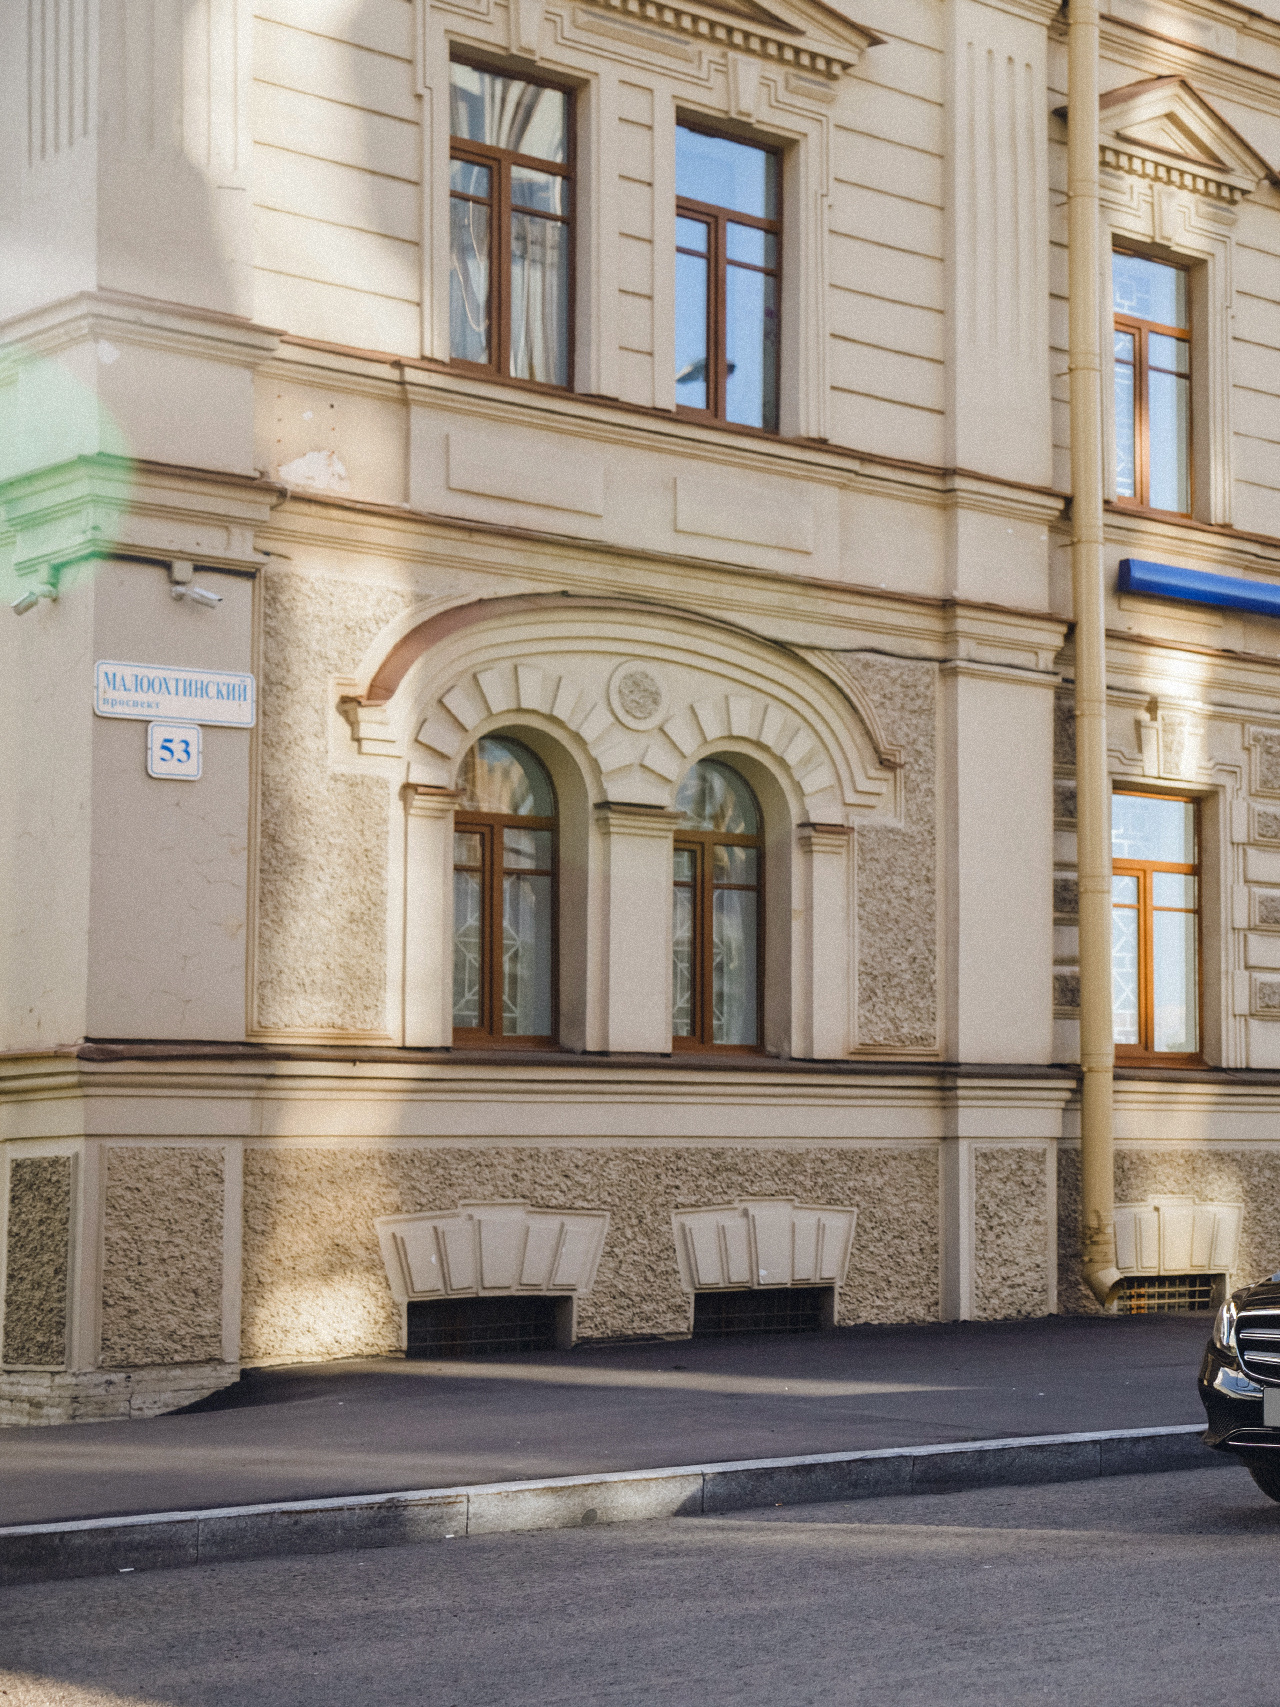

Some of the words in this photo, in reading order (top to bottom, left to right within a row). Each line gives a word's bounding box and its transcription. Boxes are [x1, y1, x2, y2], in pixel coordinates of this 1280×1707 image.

[104, 671, 248, 702] МАЛООХТИНСКИЙ
[102, 697, 160, 709] проспект
[160, 738, 191, 763] 53
